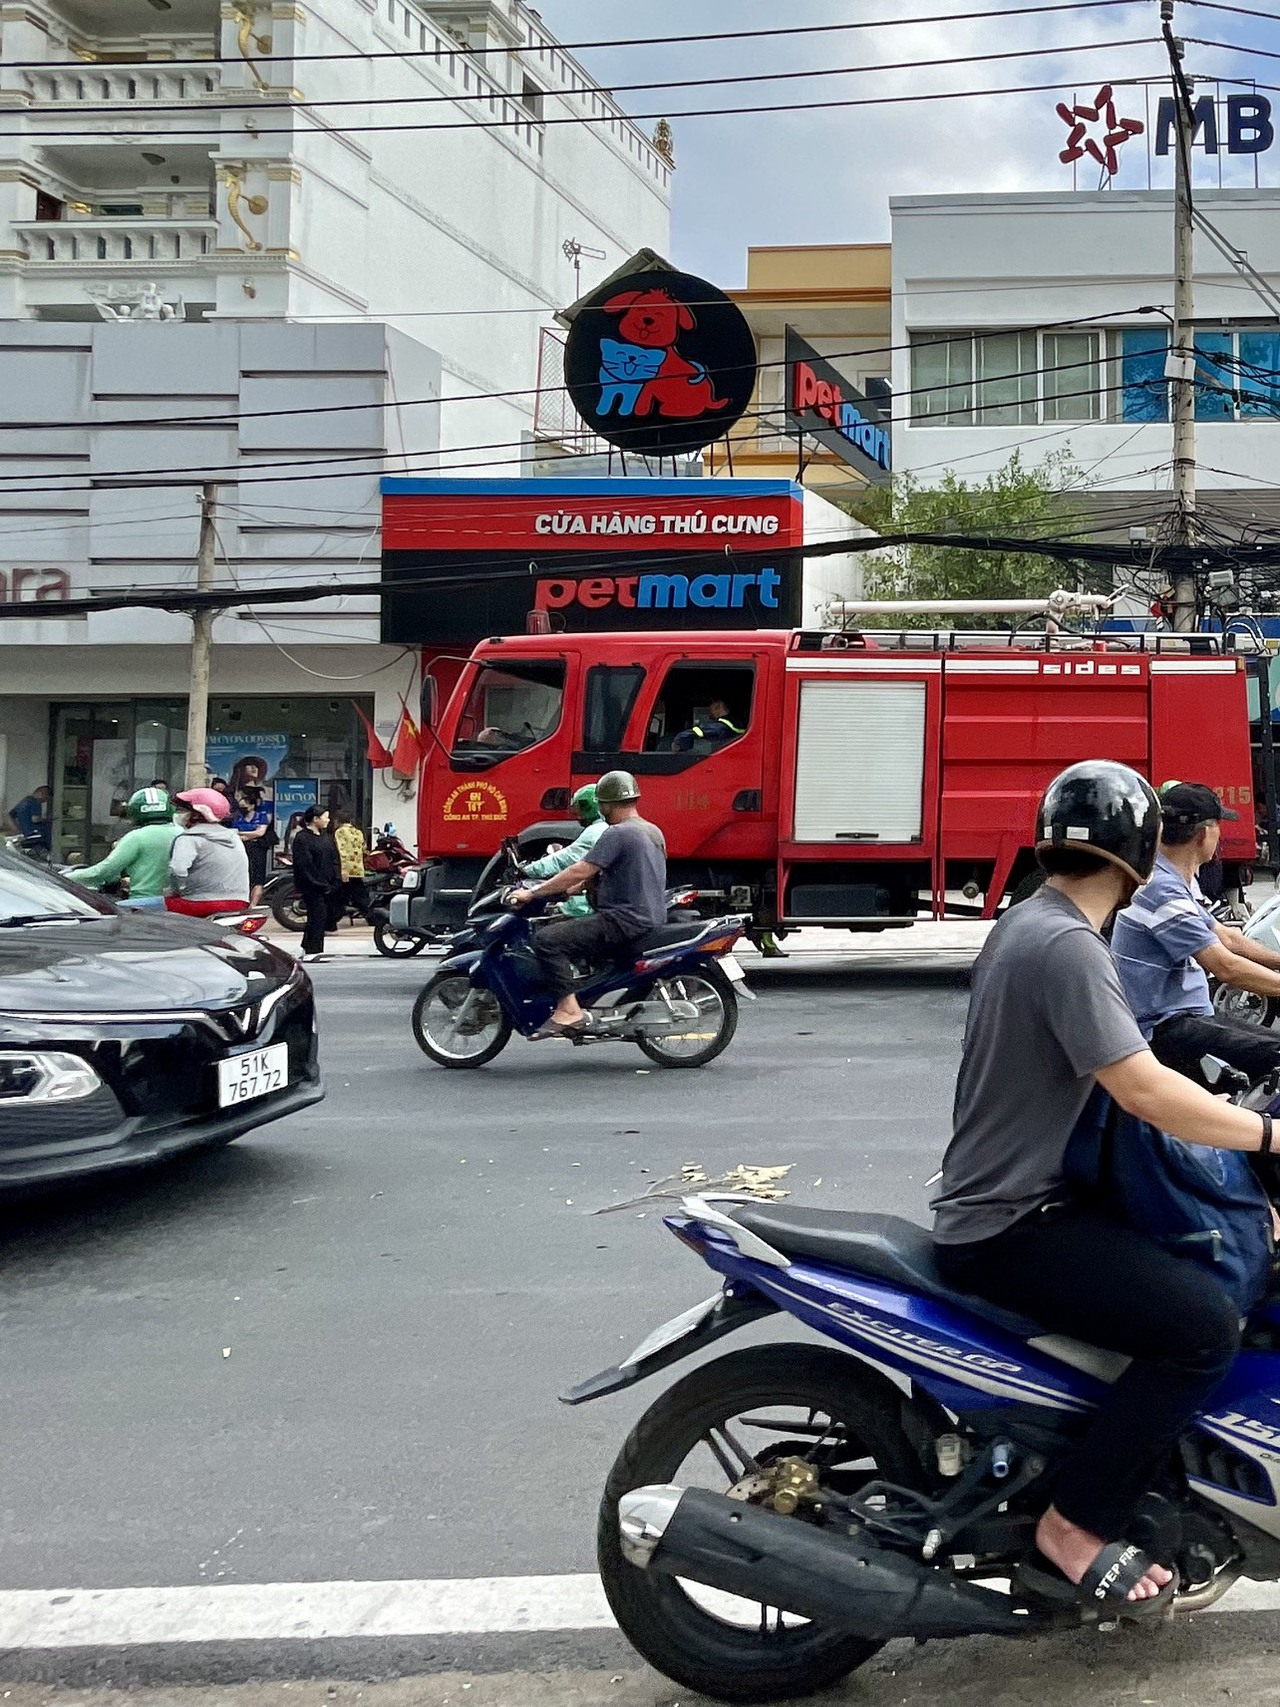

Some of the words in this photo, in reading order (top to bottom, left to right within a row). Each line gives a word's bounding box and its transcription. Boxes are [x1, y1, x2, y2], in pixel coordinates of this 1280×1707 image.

[1155, 94, 1274, 156] MB
[793, 361, 891, 471] petmart
[535, 510, 587, 534] CỬA
[591, 511, 656, 534] HÀNG
[660, 510, 707, 534] THÚ
[711, 515, 779, 535] CƯNG
[0, 568, 71, 602] ra
[534, 567, 781, 612] petmart
[1043, 660, 1141, 675] sides
[241, 1052, 269, 1076] 51K
[229, 1070, 281, 1101] 767.72
[1095, 1563, 1120, 1599] STEP
